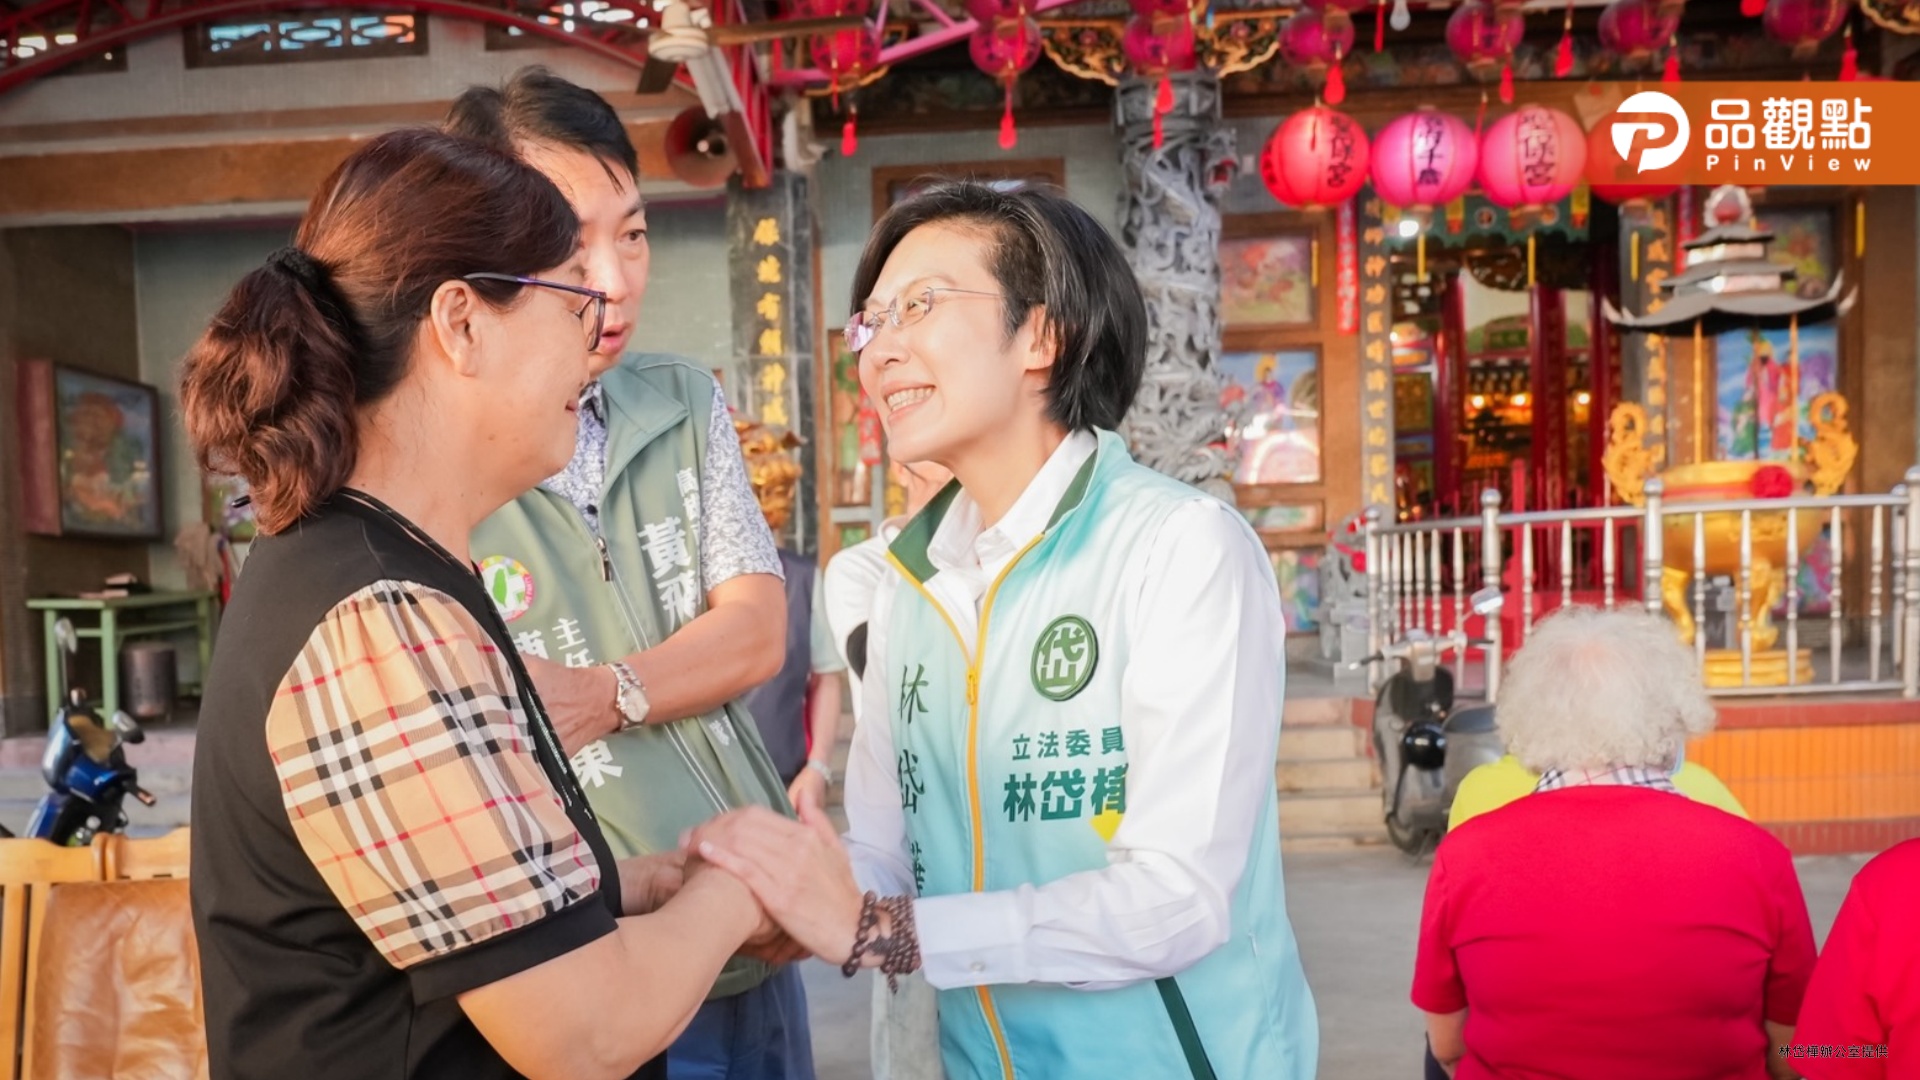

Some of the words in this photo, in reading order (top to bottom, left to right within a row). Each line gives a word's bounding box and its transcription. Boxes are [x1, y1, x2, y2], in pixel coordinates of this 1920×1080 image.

[1039, 627, 1086, 687] 岱
[1012, 726, 1126, 760] 立法委員
